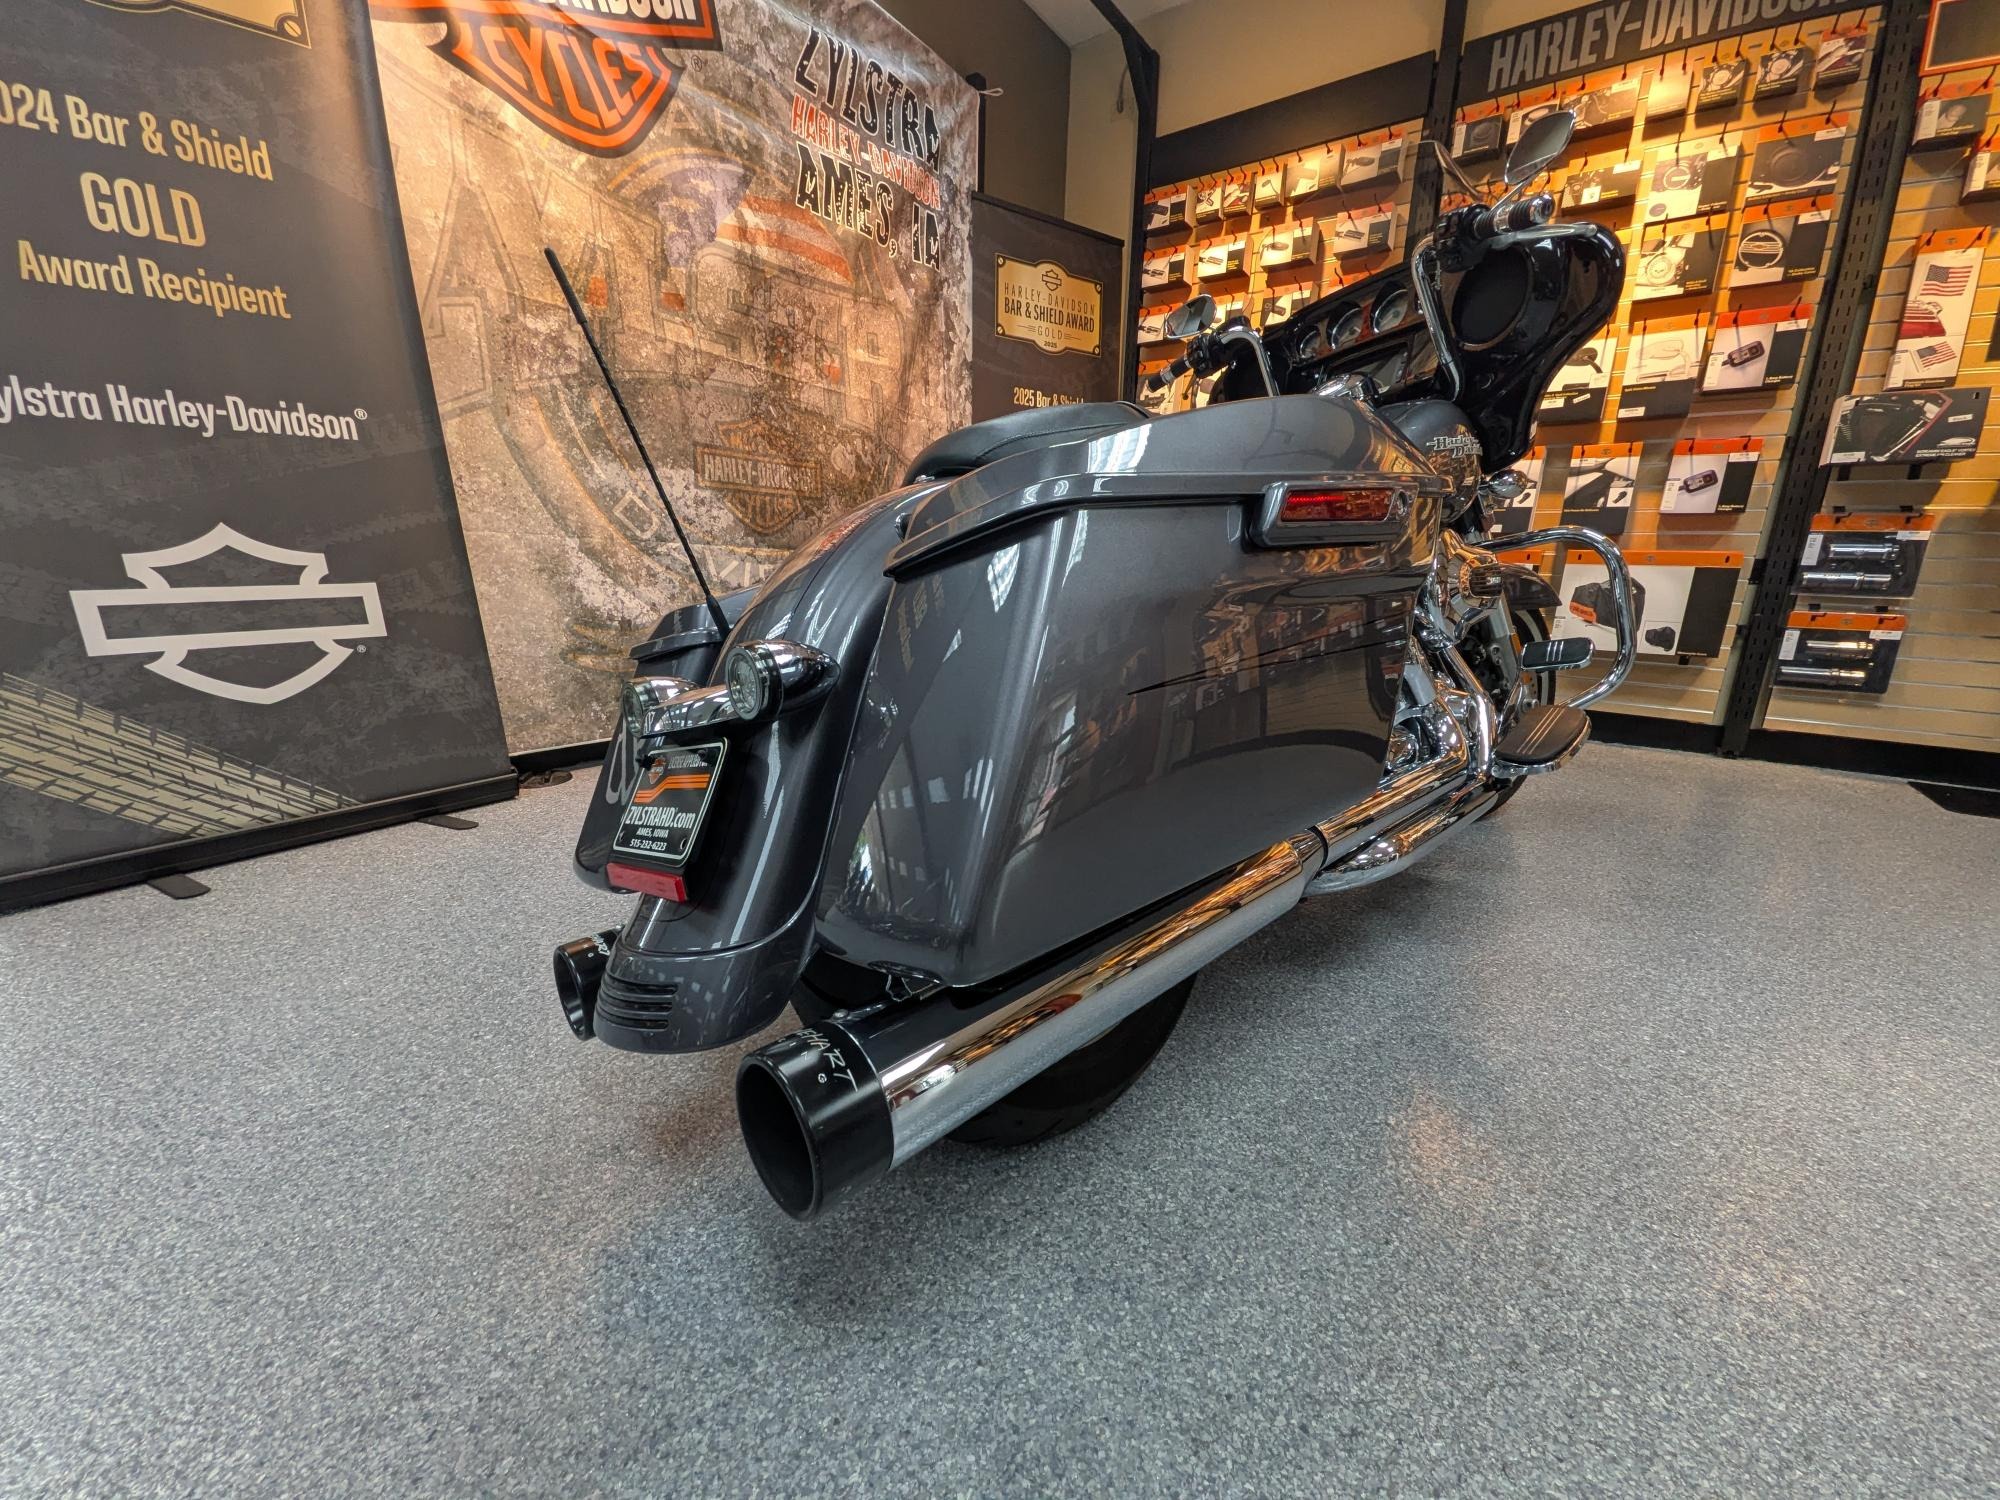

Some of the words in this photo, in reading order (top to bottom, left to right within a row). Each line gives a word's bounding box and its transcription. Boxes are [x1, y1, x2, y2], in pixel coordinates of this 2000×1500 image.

[480, 25, 654, 129] CYCLES
[794, 26, 940, 174] ZYLSTRA
[64, 94, 129, 148] Bar
[139, 110, 168, 156] &
[175, 120, 273, 181] Shield
[791, 94, 941, 211] HARLEY-DAVIDSON
[80, 172, 206, 247] GOLD
[796, 141, 897, 258] AMES,
[912, 202, 940, 272] IA
[18, 240, 134, 295] Award
[138, 257, 292, 319] Recipient
[1005, 282, 1095, 317] HARLEY-DAVIDSON
[1005, 297, 1022, 317] BAR
[1025, 302, 1031, 319] &
[1034, 304, 1064, 326] SHIELD
[1065, 312, 1095, 333] AWARD
[1037, 325, 1063, 340] GOLD
[1044, 340, 1057, 349] 2025
[1013, 387, 1035, 407] 2025
[1036, 390, 1051, 408] Bar
[1053, 393, 1059, 407] &
[625, 805, 696, 829] ZYLSTRAHD.com
[636, 827, 652, 838] AMES,
[653, 828, 669, 838] IOWA
[629, 838, 667, 851] 515-232-6223
